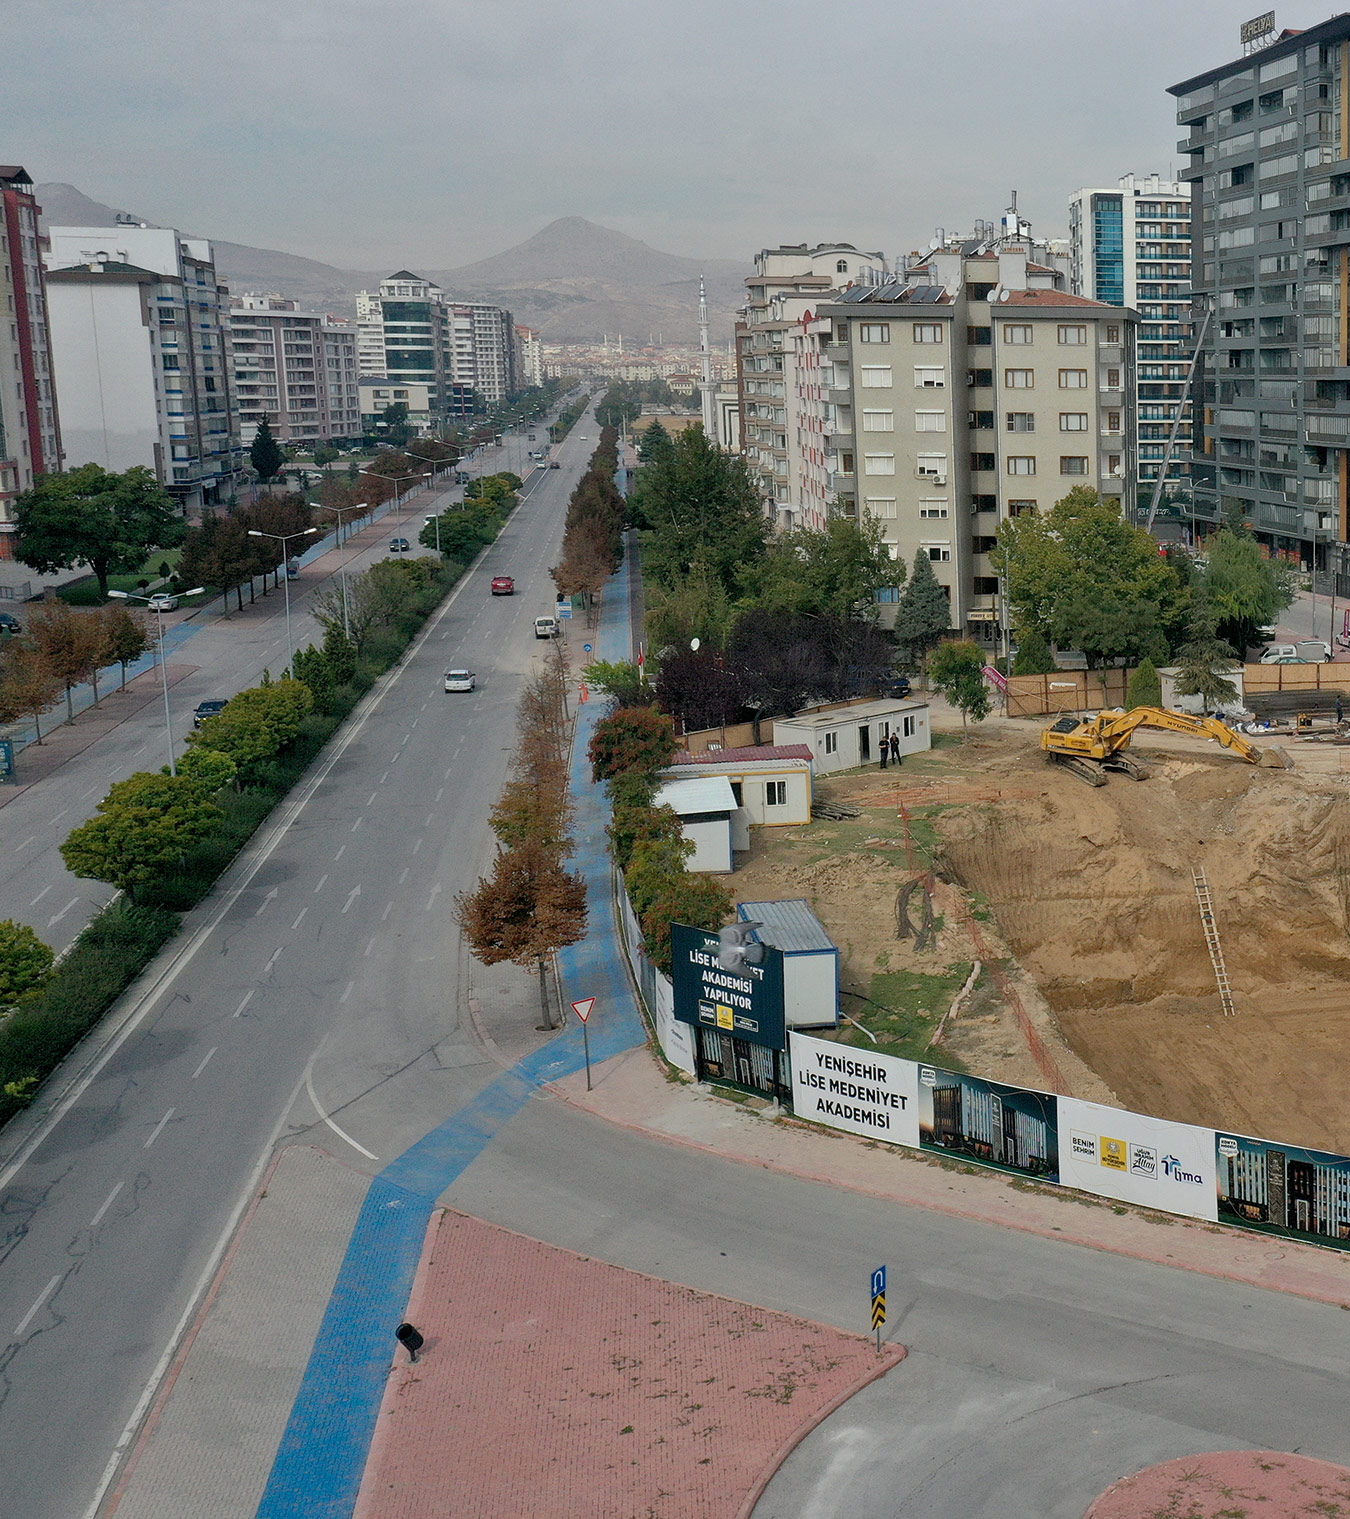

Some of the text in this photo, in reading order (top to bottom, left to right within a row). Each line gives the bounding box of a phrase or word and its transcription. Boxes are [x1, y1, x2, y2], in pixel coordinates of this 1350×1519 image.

[1167, 721, 1198, 733] HYUNDAI
[689, 948, 710, 966] LİSE
[702, 970, 753, 994] AKADEMİSİ
[703, 986, 752, 1010] YAPILIYOR
[815, 1052, 887, 1083] YENİŞEHİR
[799, 1069, 908, 1110] LİSE MEDENİYET
[816, 1098, 890, 1129] AKADEMİSİ
